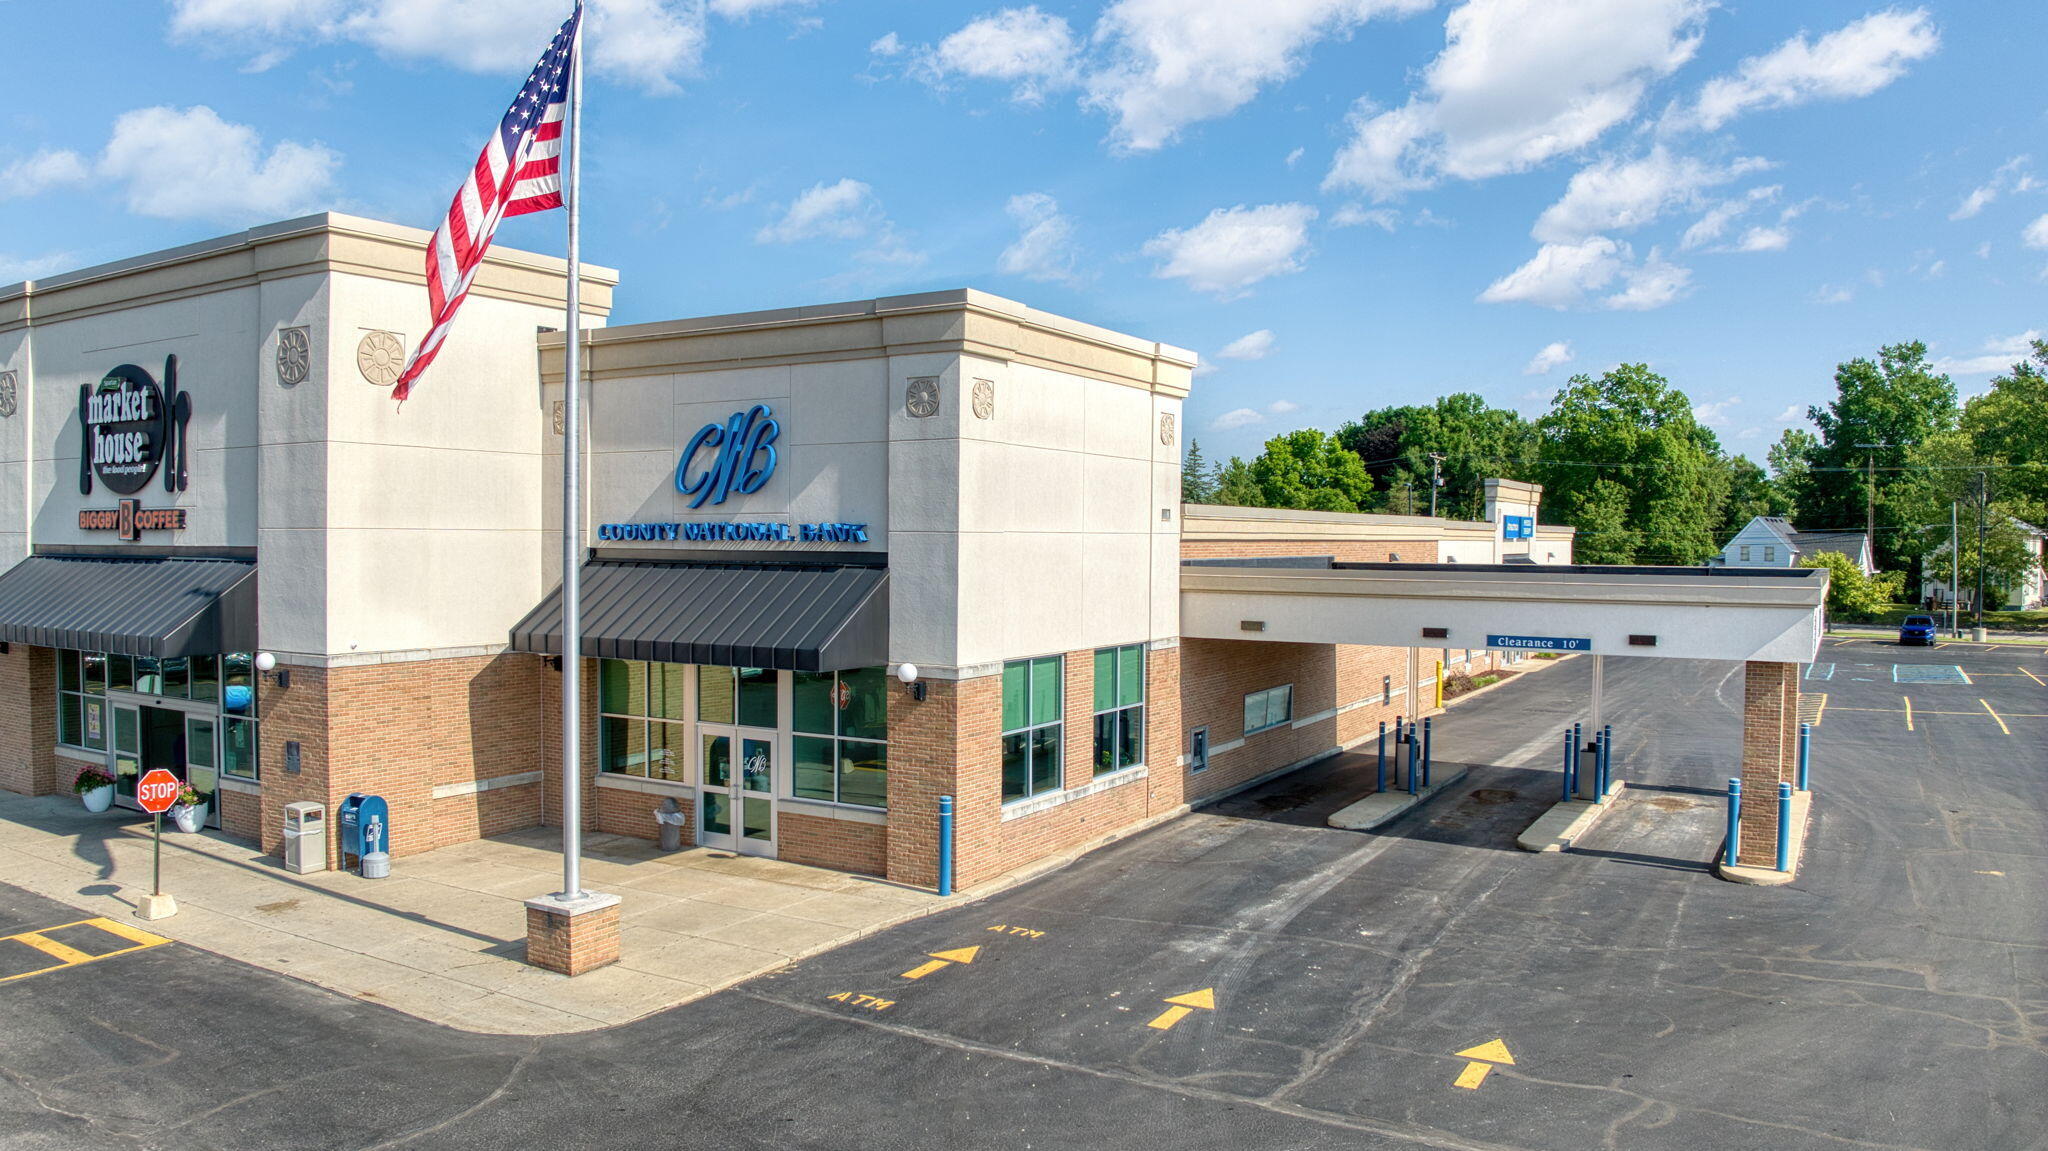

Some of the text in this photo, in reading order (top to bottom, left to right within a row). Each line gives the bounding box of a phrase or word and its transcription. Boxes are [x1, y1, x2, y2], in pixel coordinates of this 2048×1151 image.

[88, 381, 149, 424] market
[93, 425, 143, 464] house
[80, 511, 118, 529] BIGGBY
[135, 510, 180, 529] COFFEE
[598, 522, 869, 543] COUNTY NATIONAL BANK
[1497, 637, 1580, 649] Clearance 10'
[140, 782, 176, 800] STOP
[986, 924, 1046, 939] ATM
[826, 991, 897, 1011] ATM
